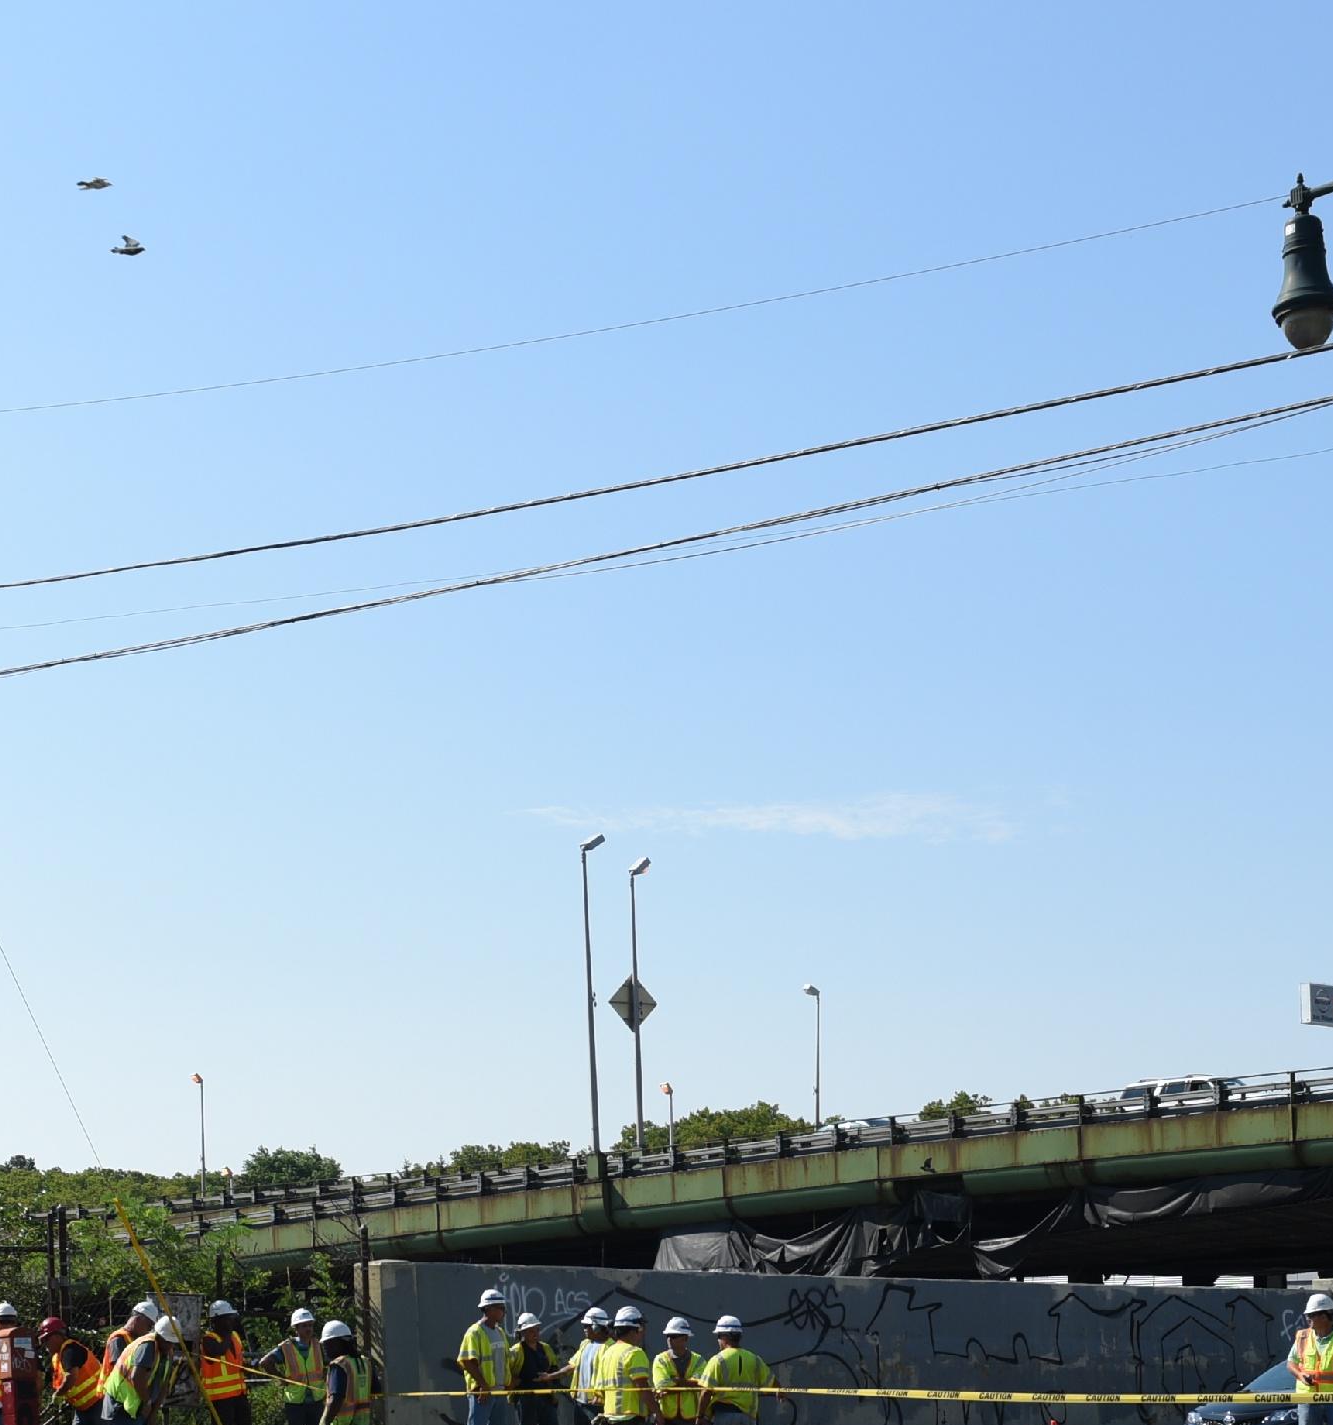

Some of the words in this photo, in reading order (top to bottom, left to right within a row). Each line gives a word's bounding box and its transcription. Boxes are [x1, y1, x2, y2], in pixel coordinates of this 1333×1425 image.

[927, 1391, 959, 1399] CAUTION
[979, 1392, 1012, 1400] CAUTION
[1032, 1393, 1065, 1401] CAUTION
[1141, 1394, 1176, 1402] CAUTION
[1197, 1394, 1233, 1402] CAUTION
[1255, 1394, 1291, 1402] CAUTION
